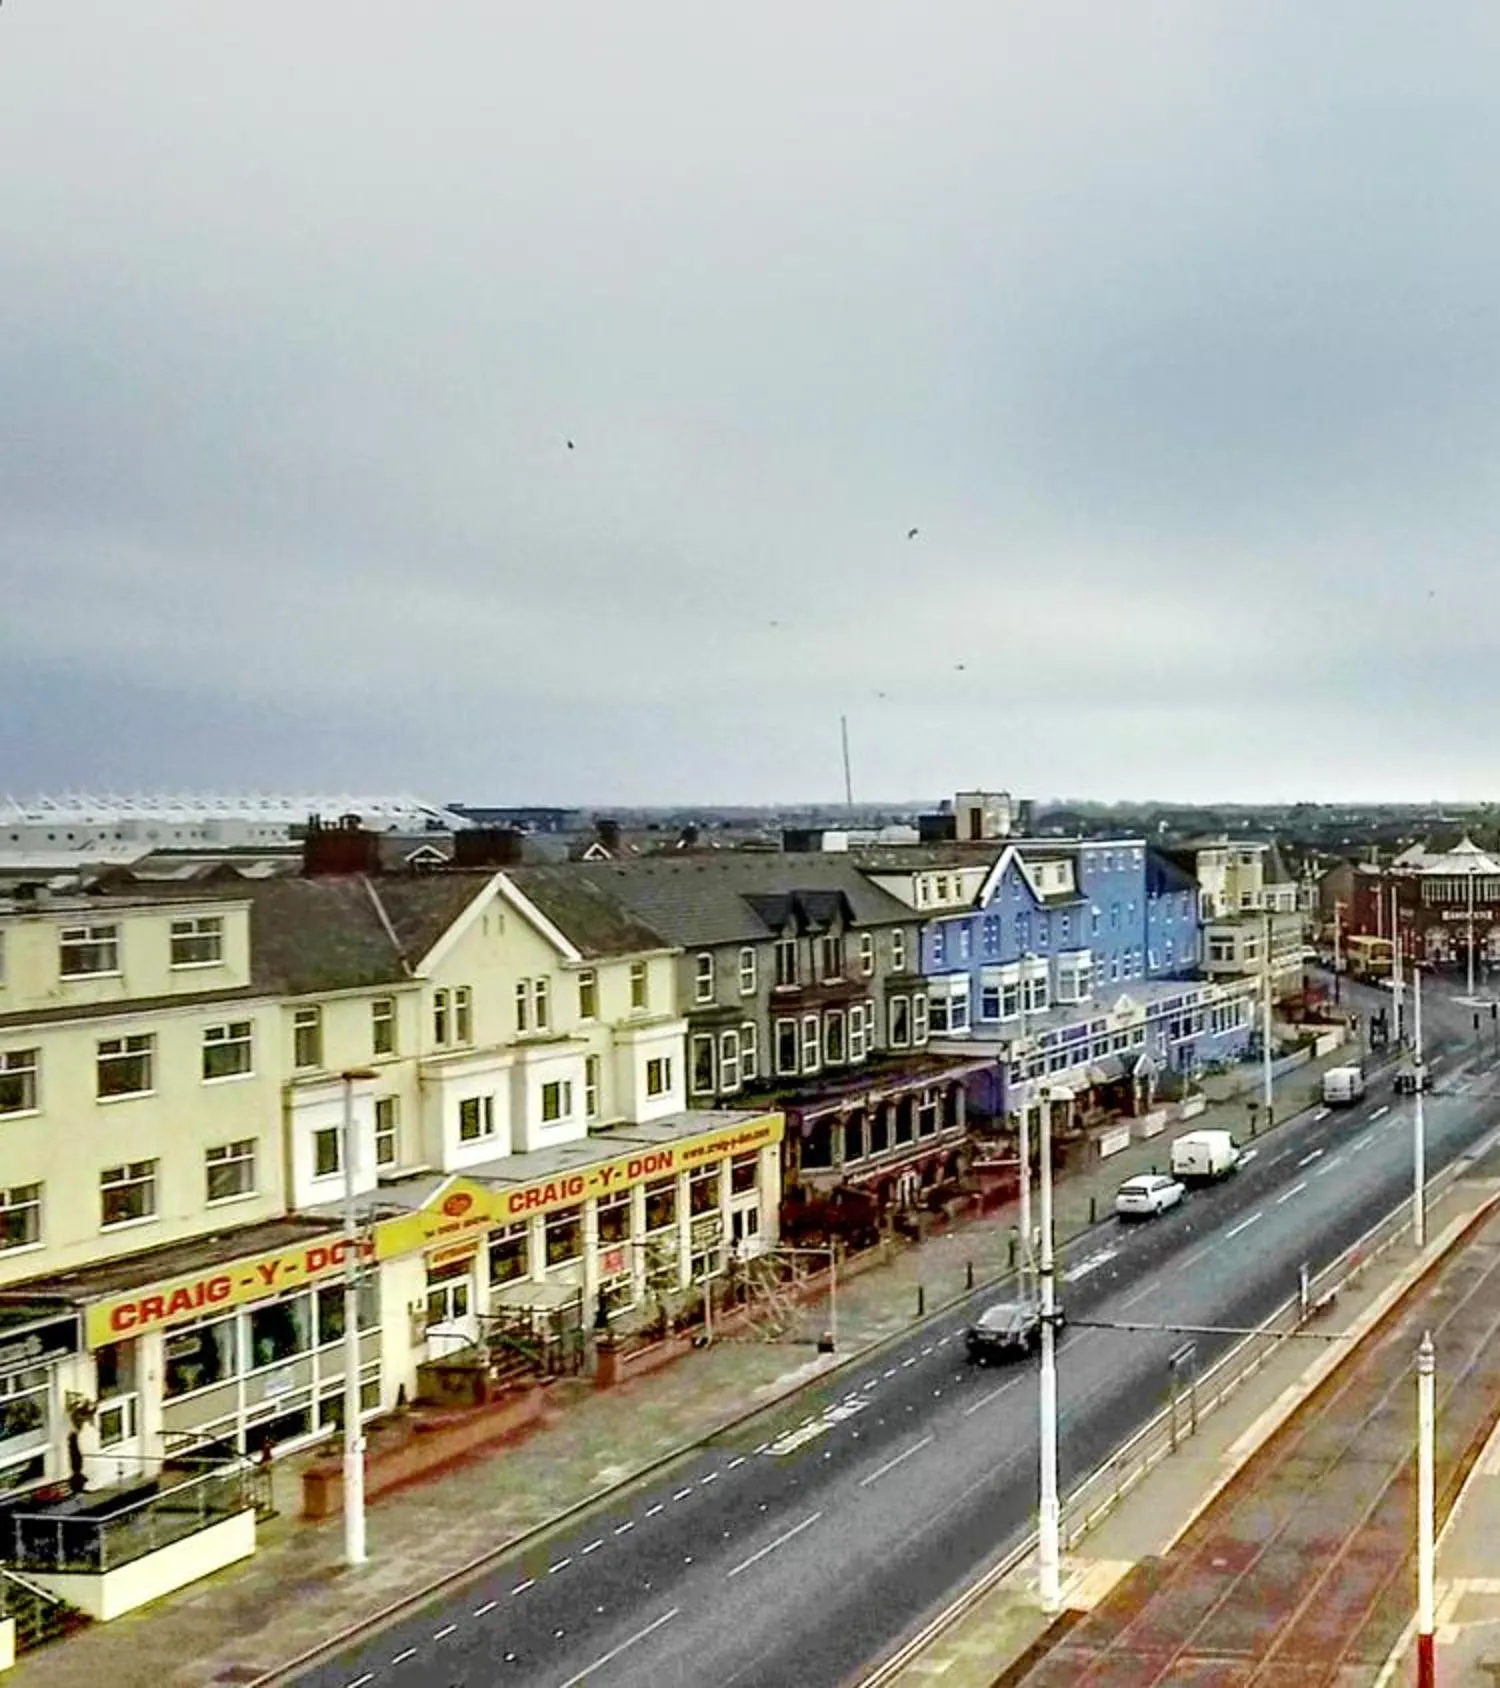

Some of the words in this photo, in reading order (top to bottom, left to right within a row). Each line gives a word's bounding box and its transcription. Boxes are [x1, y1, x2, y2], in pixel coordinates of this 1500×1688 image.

[508, 1176, 584, 1213] CRAIG
[627, 1151, 673, 1179] DON
[110, 1274, 231, 1331] CRAIG
